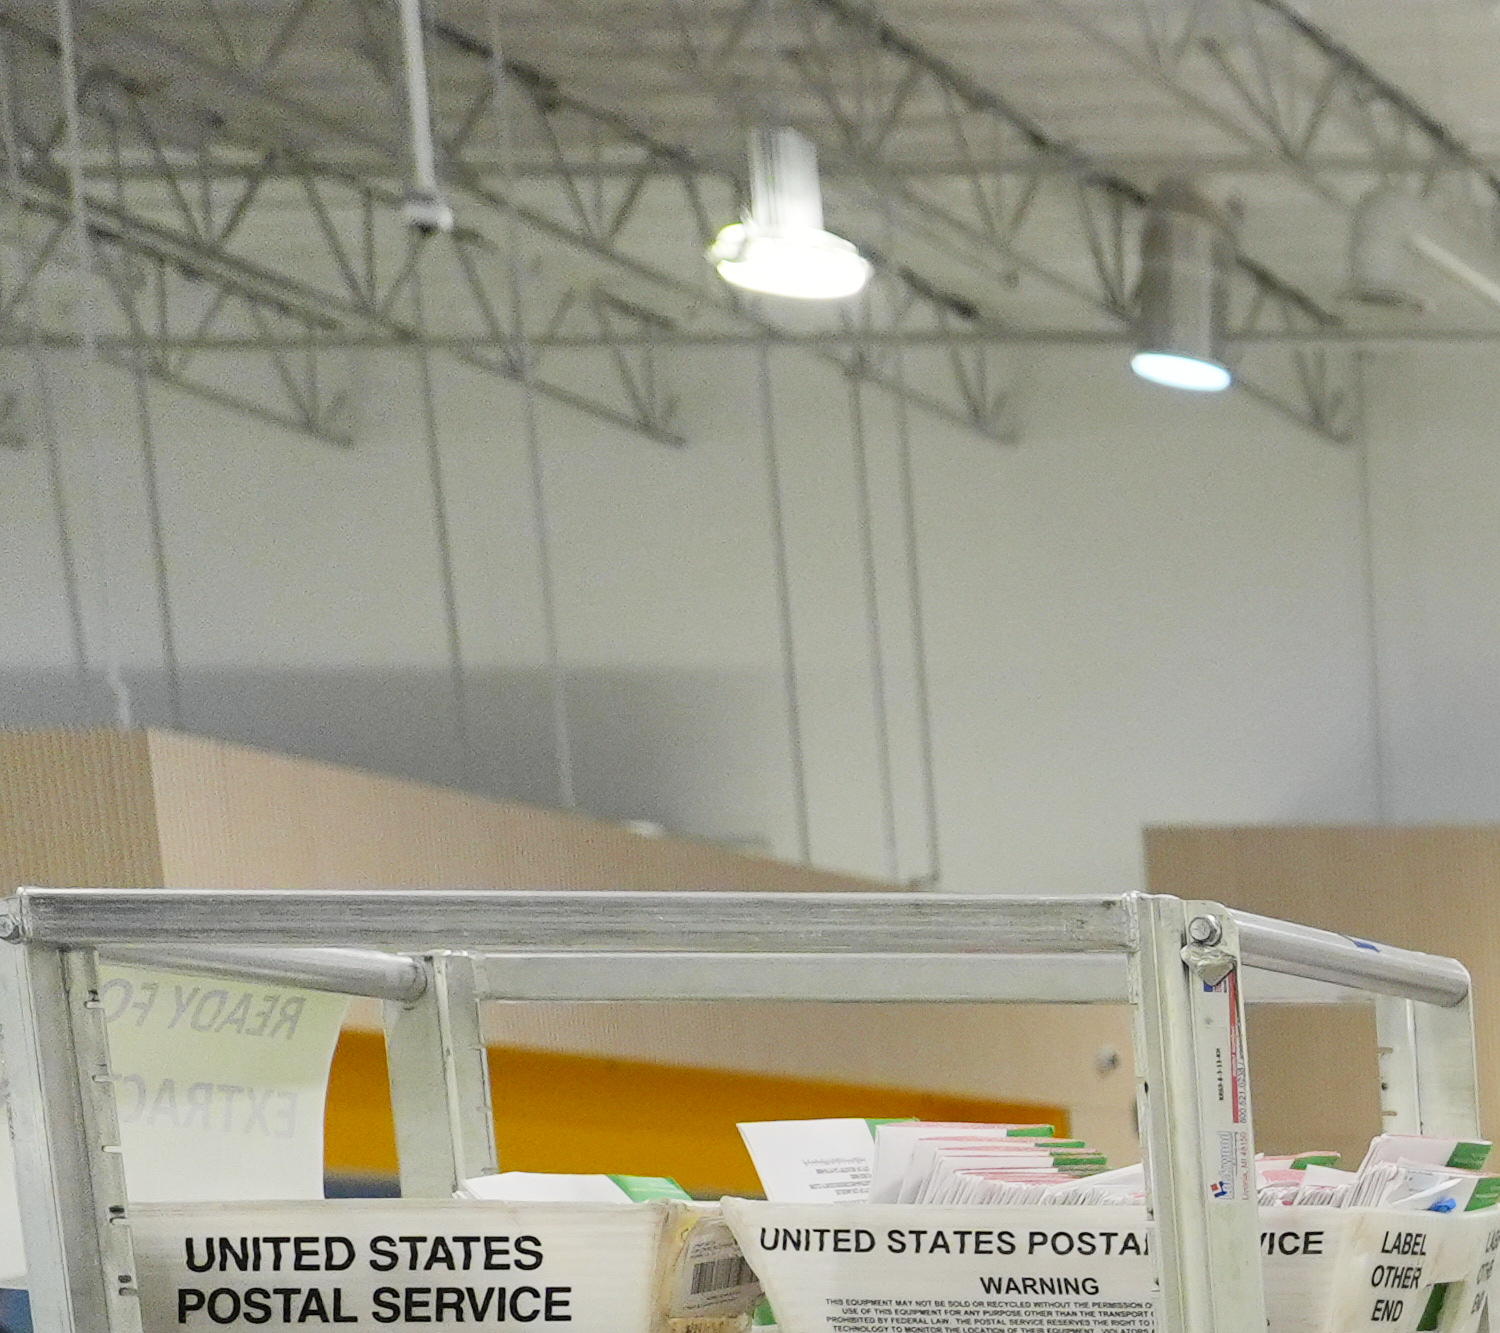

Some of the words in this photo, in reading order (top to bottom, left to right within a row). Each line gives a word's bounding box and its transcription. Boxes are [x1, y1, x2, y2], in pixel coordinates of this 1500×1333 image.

[185, 1236, 356, 1274] UNITED
[369, 1235, 544, 1272] STATES
[760, 1227, 876, 1253] UNITED
[887, 1229, 1016, 1255] STATES
[1027, 1231, 1149, 1256] POSTA
[1380, 1230, 1427, 1257] LABEL
[979, 1276, 1100, 1296] WARNING
[1370, 1264, 1423, 1290] OTHER
[177, 1287, 359, 1325] POSTAL
[371, 1286, 572, 1324] SERVICE
[1370, 1299, 1404, 1322] END
